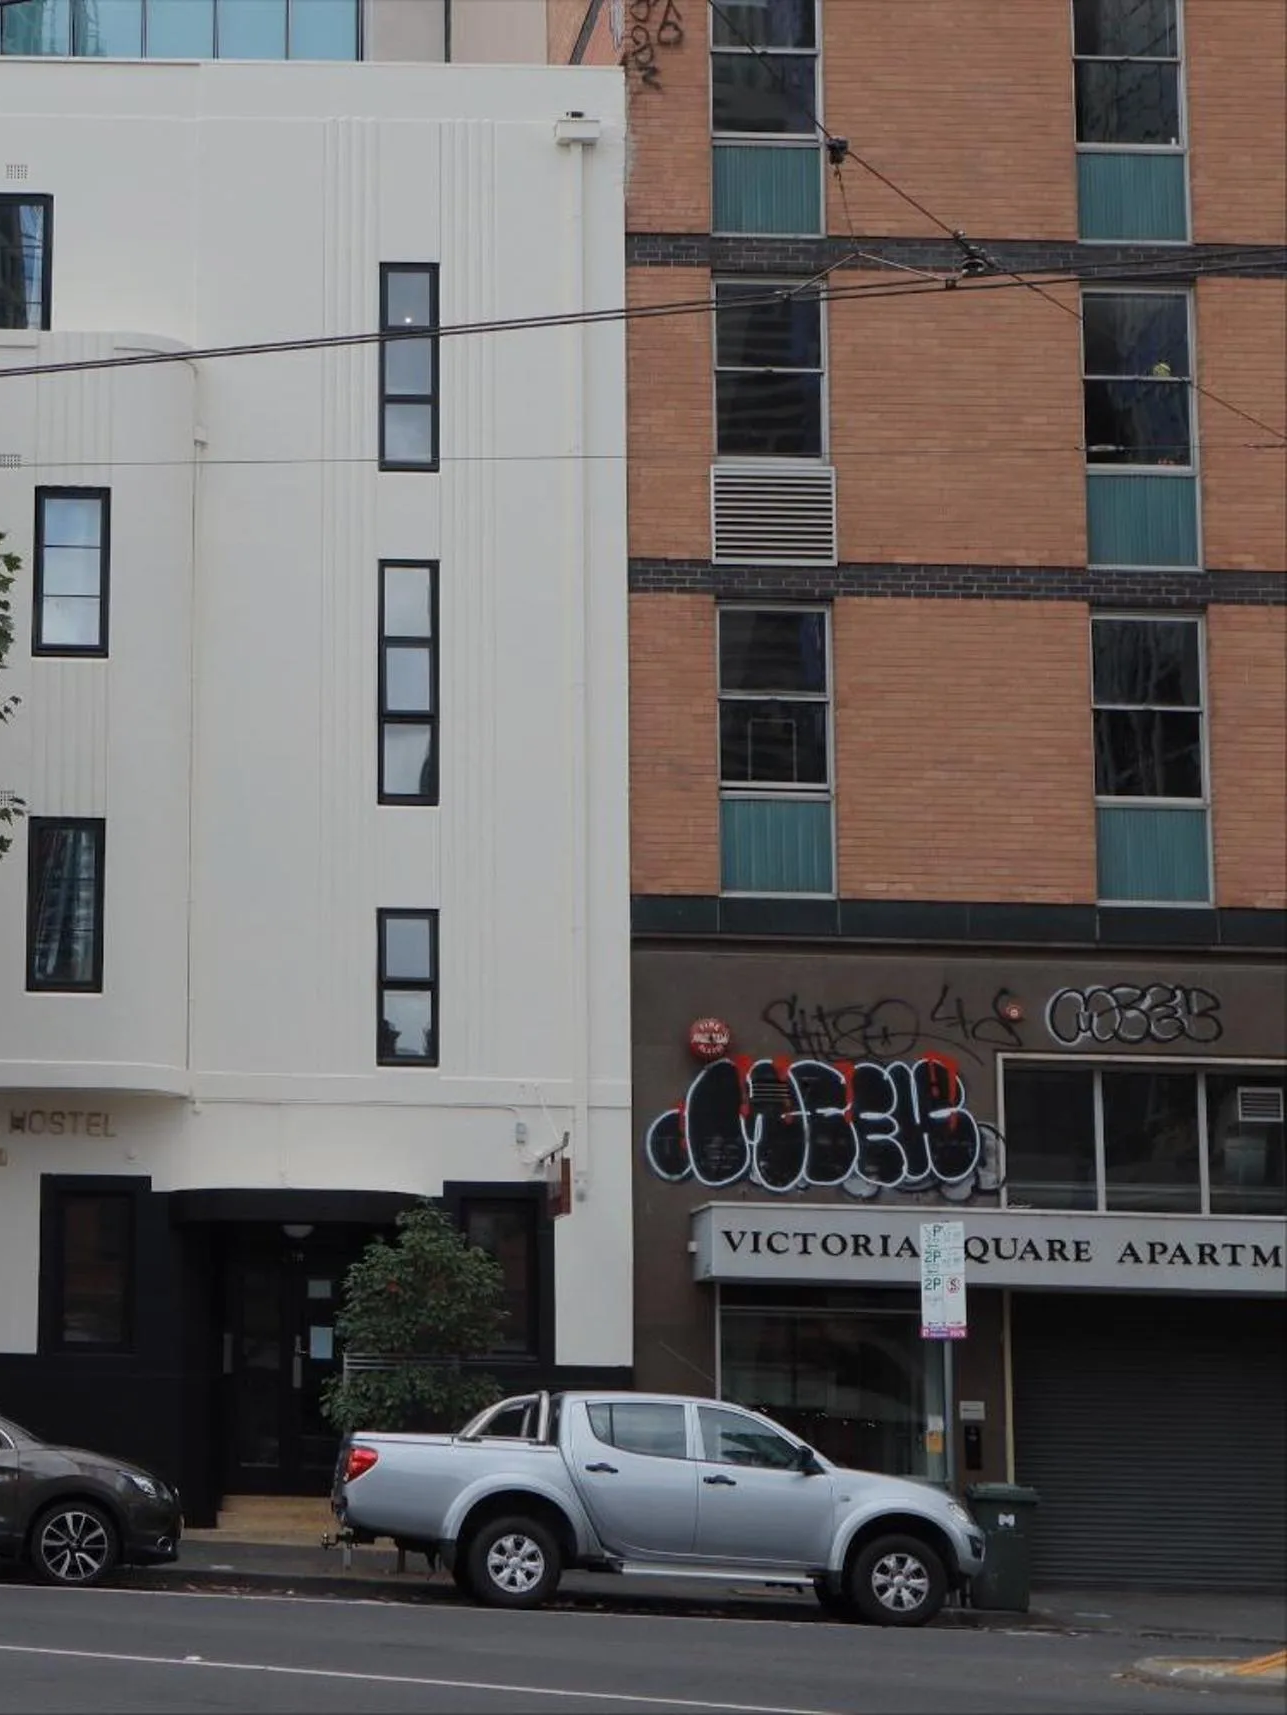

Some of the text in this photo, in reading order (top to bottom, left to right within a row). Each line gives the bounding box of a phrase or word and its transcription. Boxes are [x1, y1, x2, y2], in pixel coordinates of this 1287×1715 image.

[9, 1109, 118, 1138] HOSTEL
[721, 1230, 921, 1259] VICTORIA
[964, 1235, 1093, 1265] QUARE
[1117, 1241, 1282, 1269] APARTM
[924, 1277, 942, 1291] 2P
